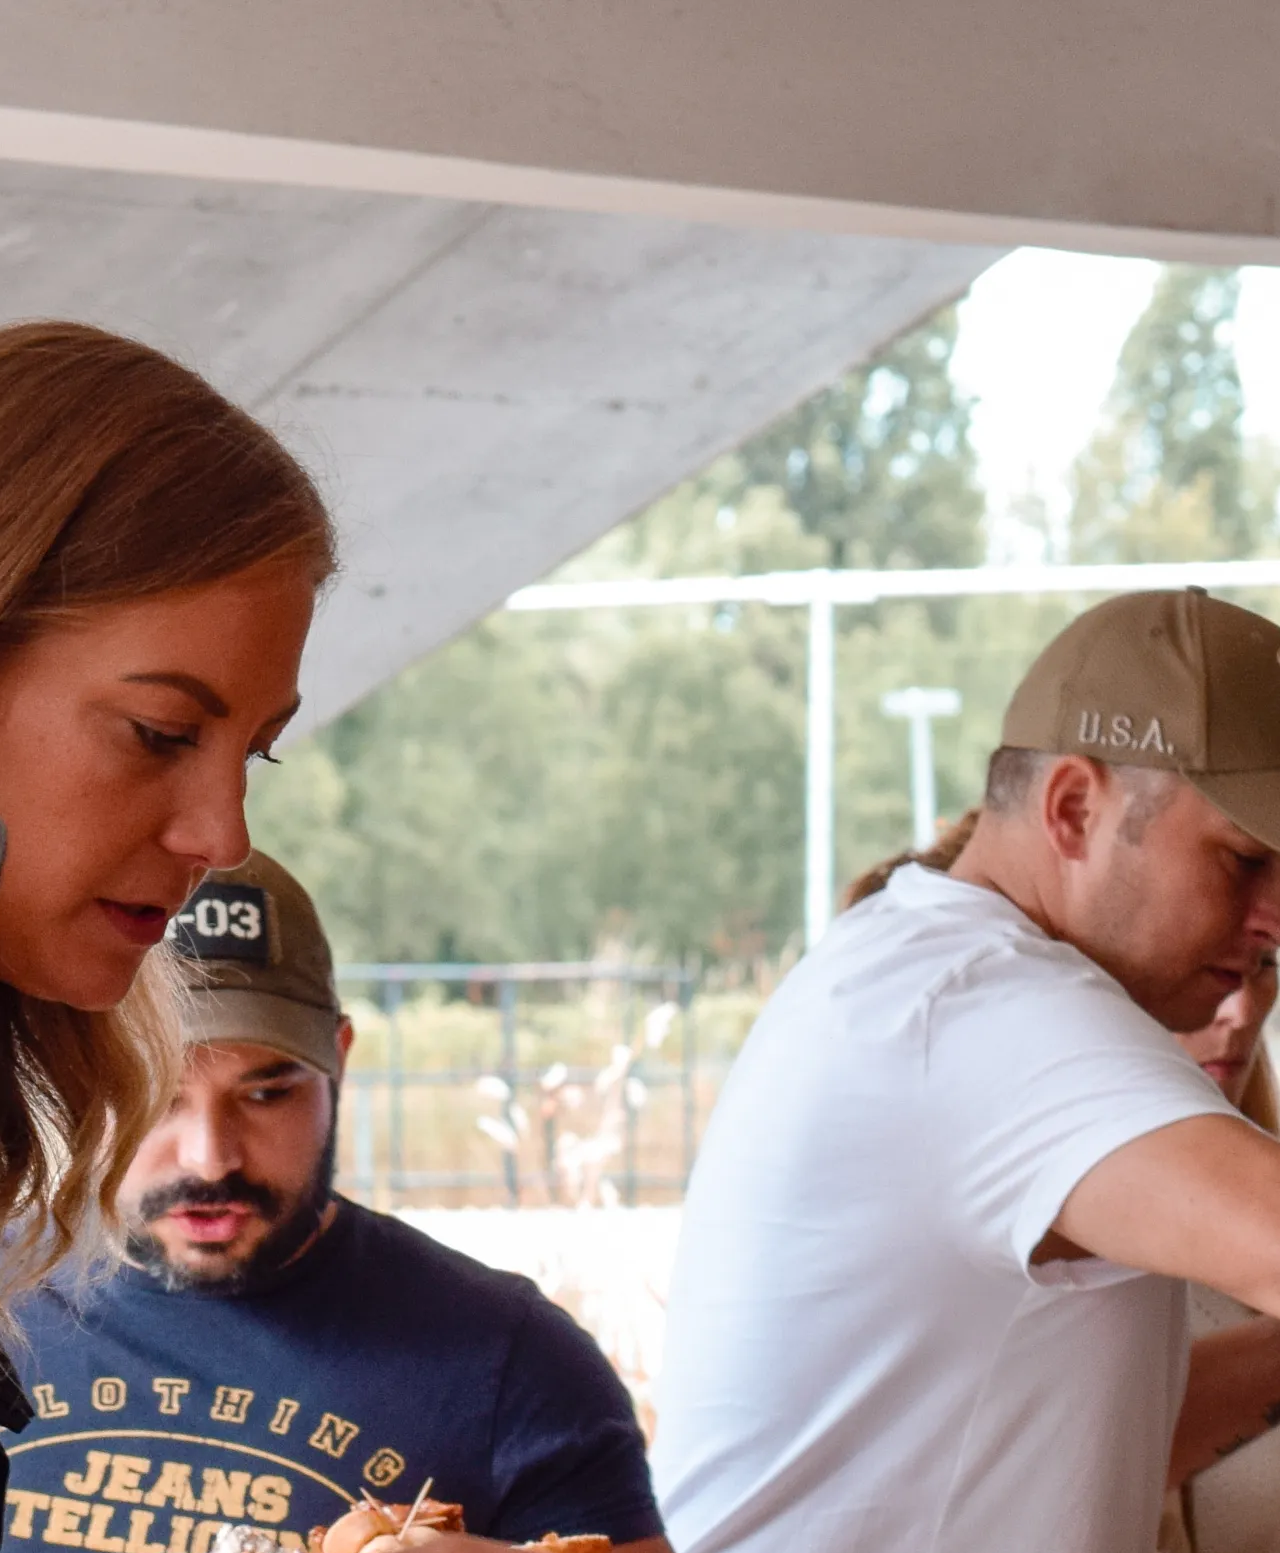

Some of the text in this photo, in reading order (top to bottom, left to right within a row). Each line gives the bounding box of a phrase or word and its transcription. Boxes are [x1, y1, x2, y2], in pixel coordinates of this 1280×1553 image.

[1079, 710, 1174, 755] U.S.A.
[163, 898, 262, 940] -03
[63, 1450, 293, 1523] JEANS
